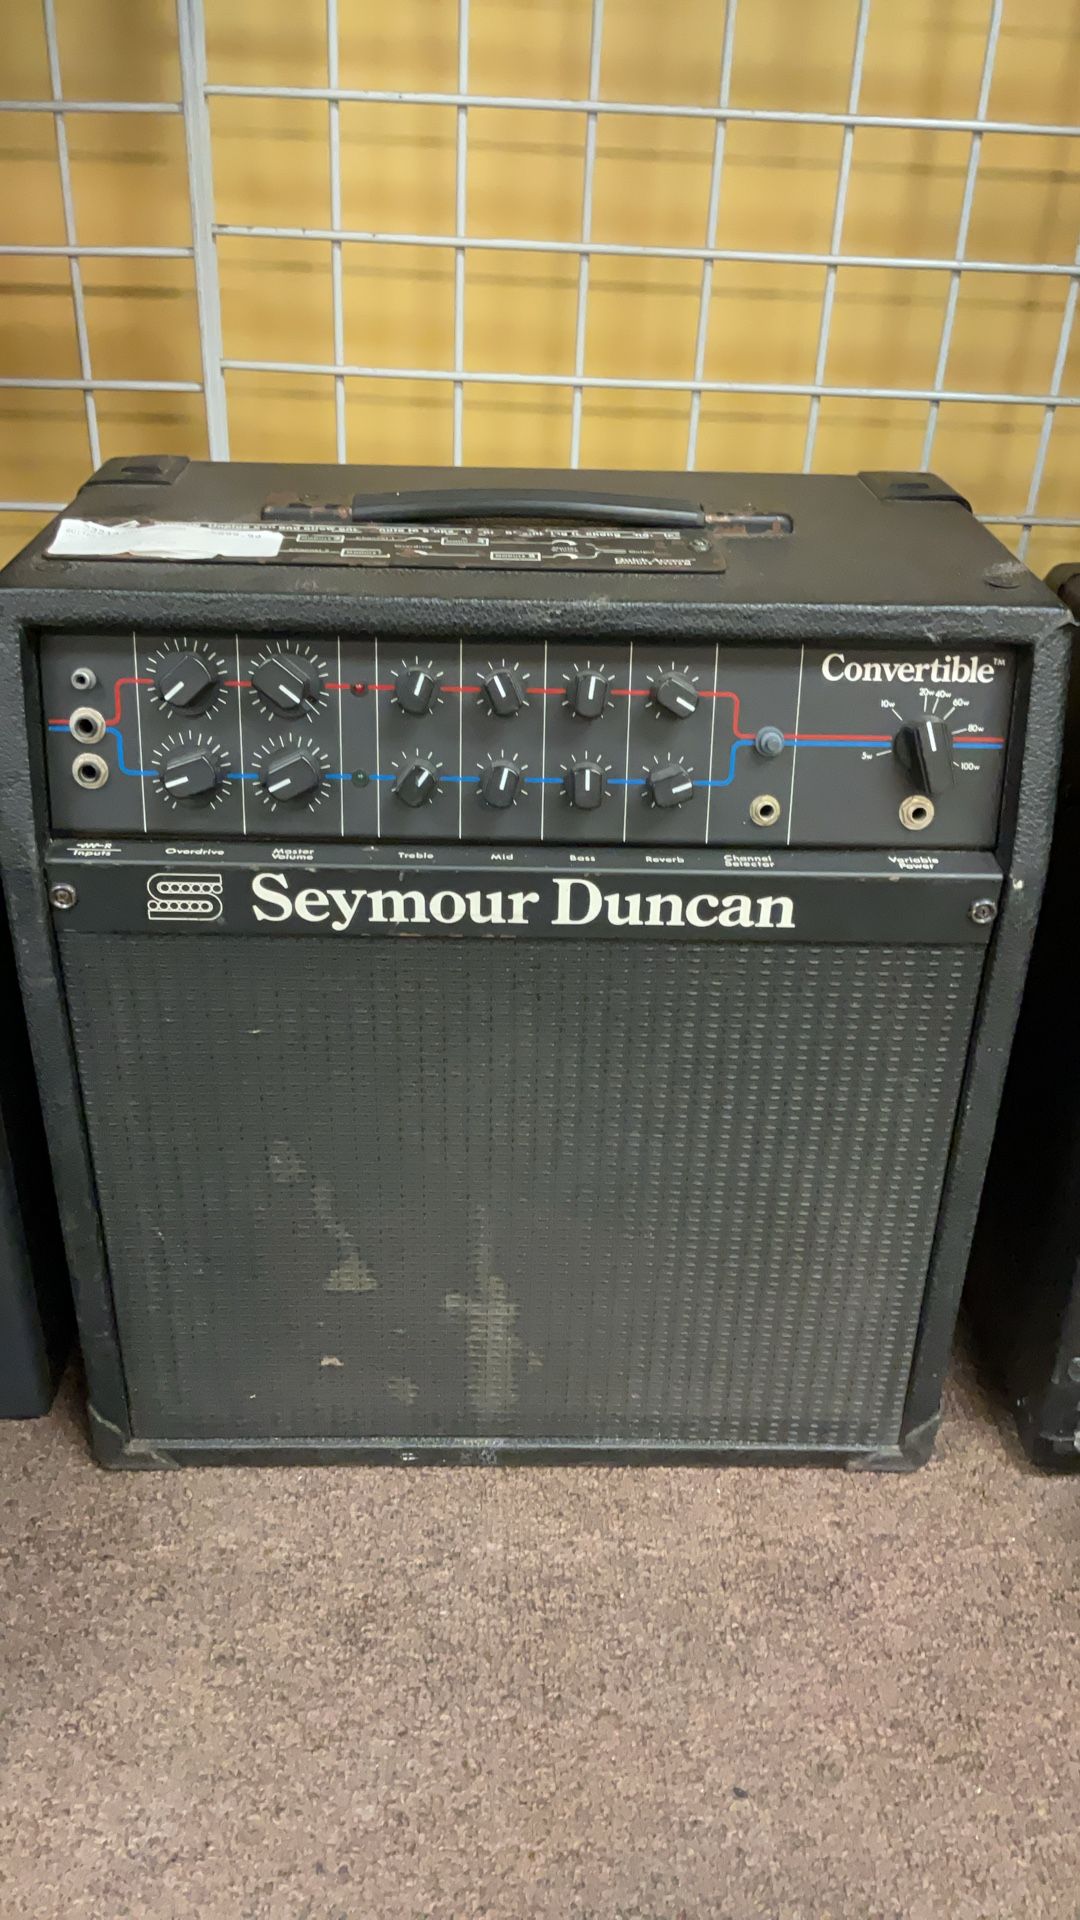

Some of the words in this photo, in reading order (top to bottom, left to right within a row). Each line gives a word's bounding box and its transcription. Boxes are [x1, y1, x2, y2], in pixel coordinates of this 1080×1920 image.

[821, 653, 995, 684] Convertible
[919, 688, 934, 697] 20w
[935, 690, 952, 699] 40w
[880, 699, 896, 708] 10w
[952, 698, 970, 707] 60w
[967, 724, 985, 733] 80w
[861, 751, 873, 760] 5w
[960, 762, 980, 771] 100w
[165, 847, 225, 856] Overdrive
[398, 851, 434, 860] Treble
[272, 853, 314, 861] Volume
[490, 853, 514, 861] Mid
[645, 856, 685, 864] Reverb
[723, 854, 773, 862] Channel
[888, 855, 939, 864] Variable
[724, 860, 775, 868] Selector
[251, 872, 540, 931] Seymour
[551, 878, 797, 929] Duncan
